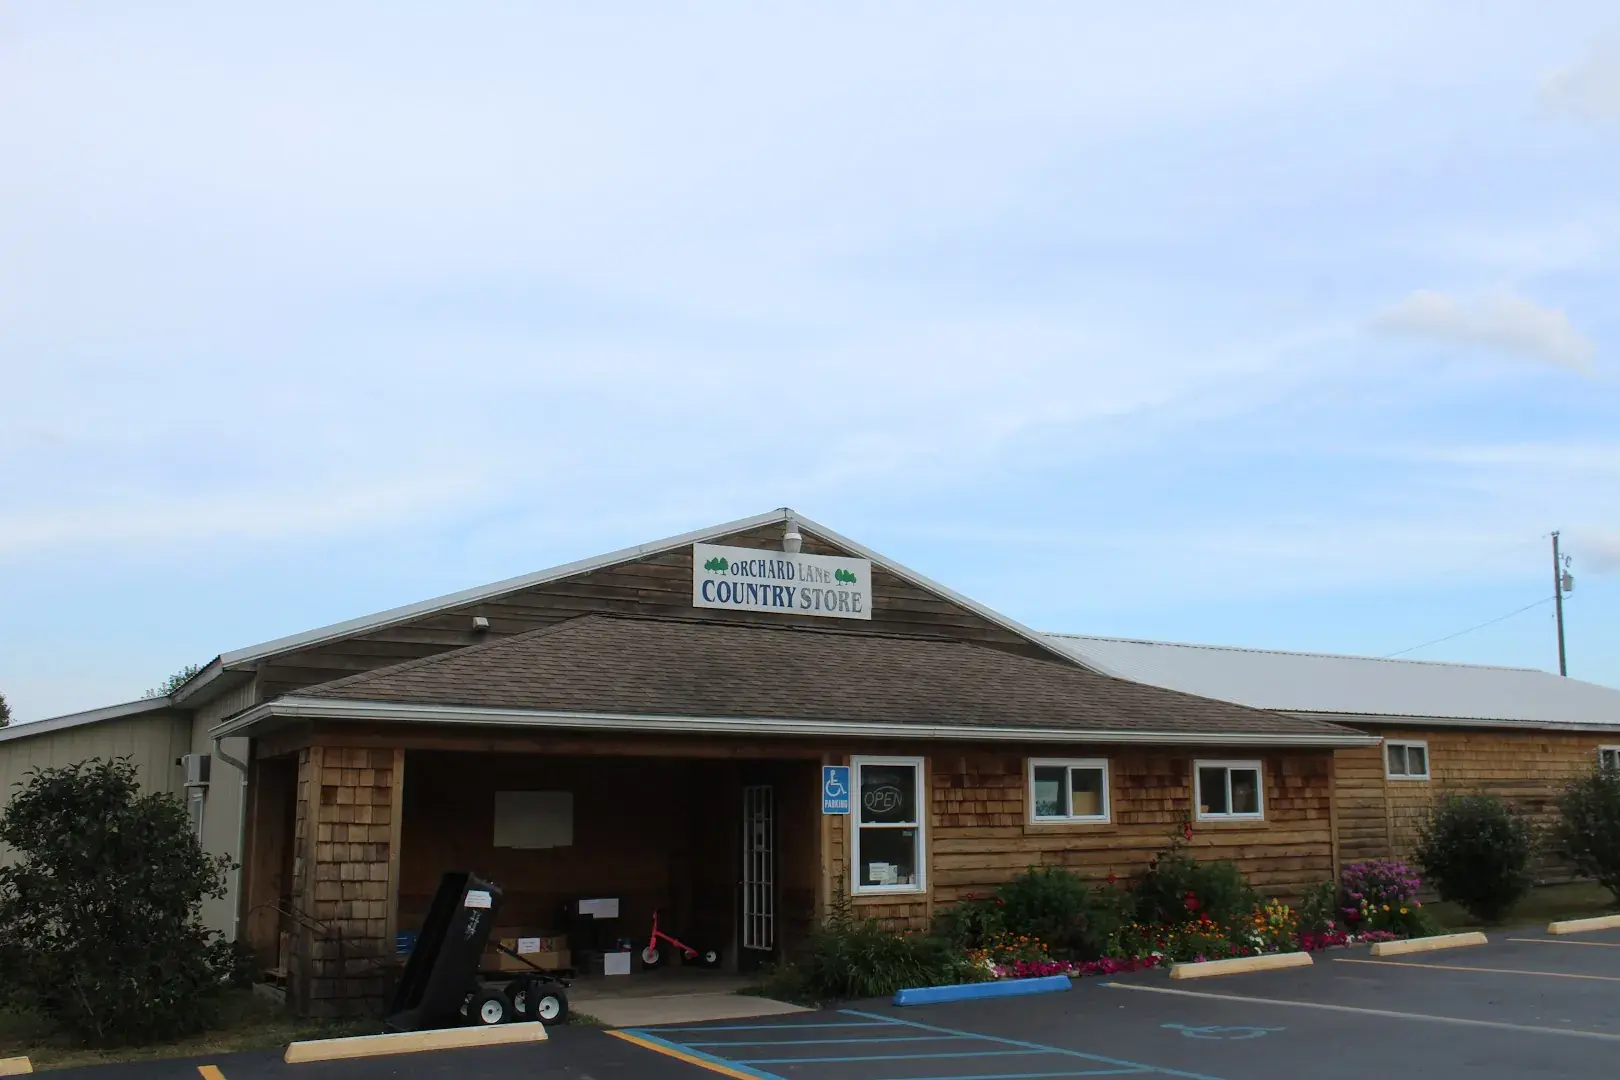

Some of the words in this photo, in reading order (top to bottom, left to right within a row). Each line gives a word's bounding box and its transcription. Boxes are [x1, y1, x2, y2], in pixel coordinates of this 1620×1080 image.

[731, 559, 795, 581] ORCHARD
[798, 563, 831, 584] LANE
[702, 580, 797, 608] COUNTRY
[800, 588, 863, 613] STORE
[824, 800, 848, 809] PARKING
[864, 792, 903, 808] OPEN
